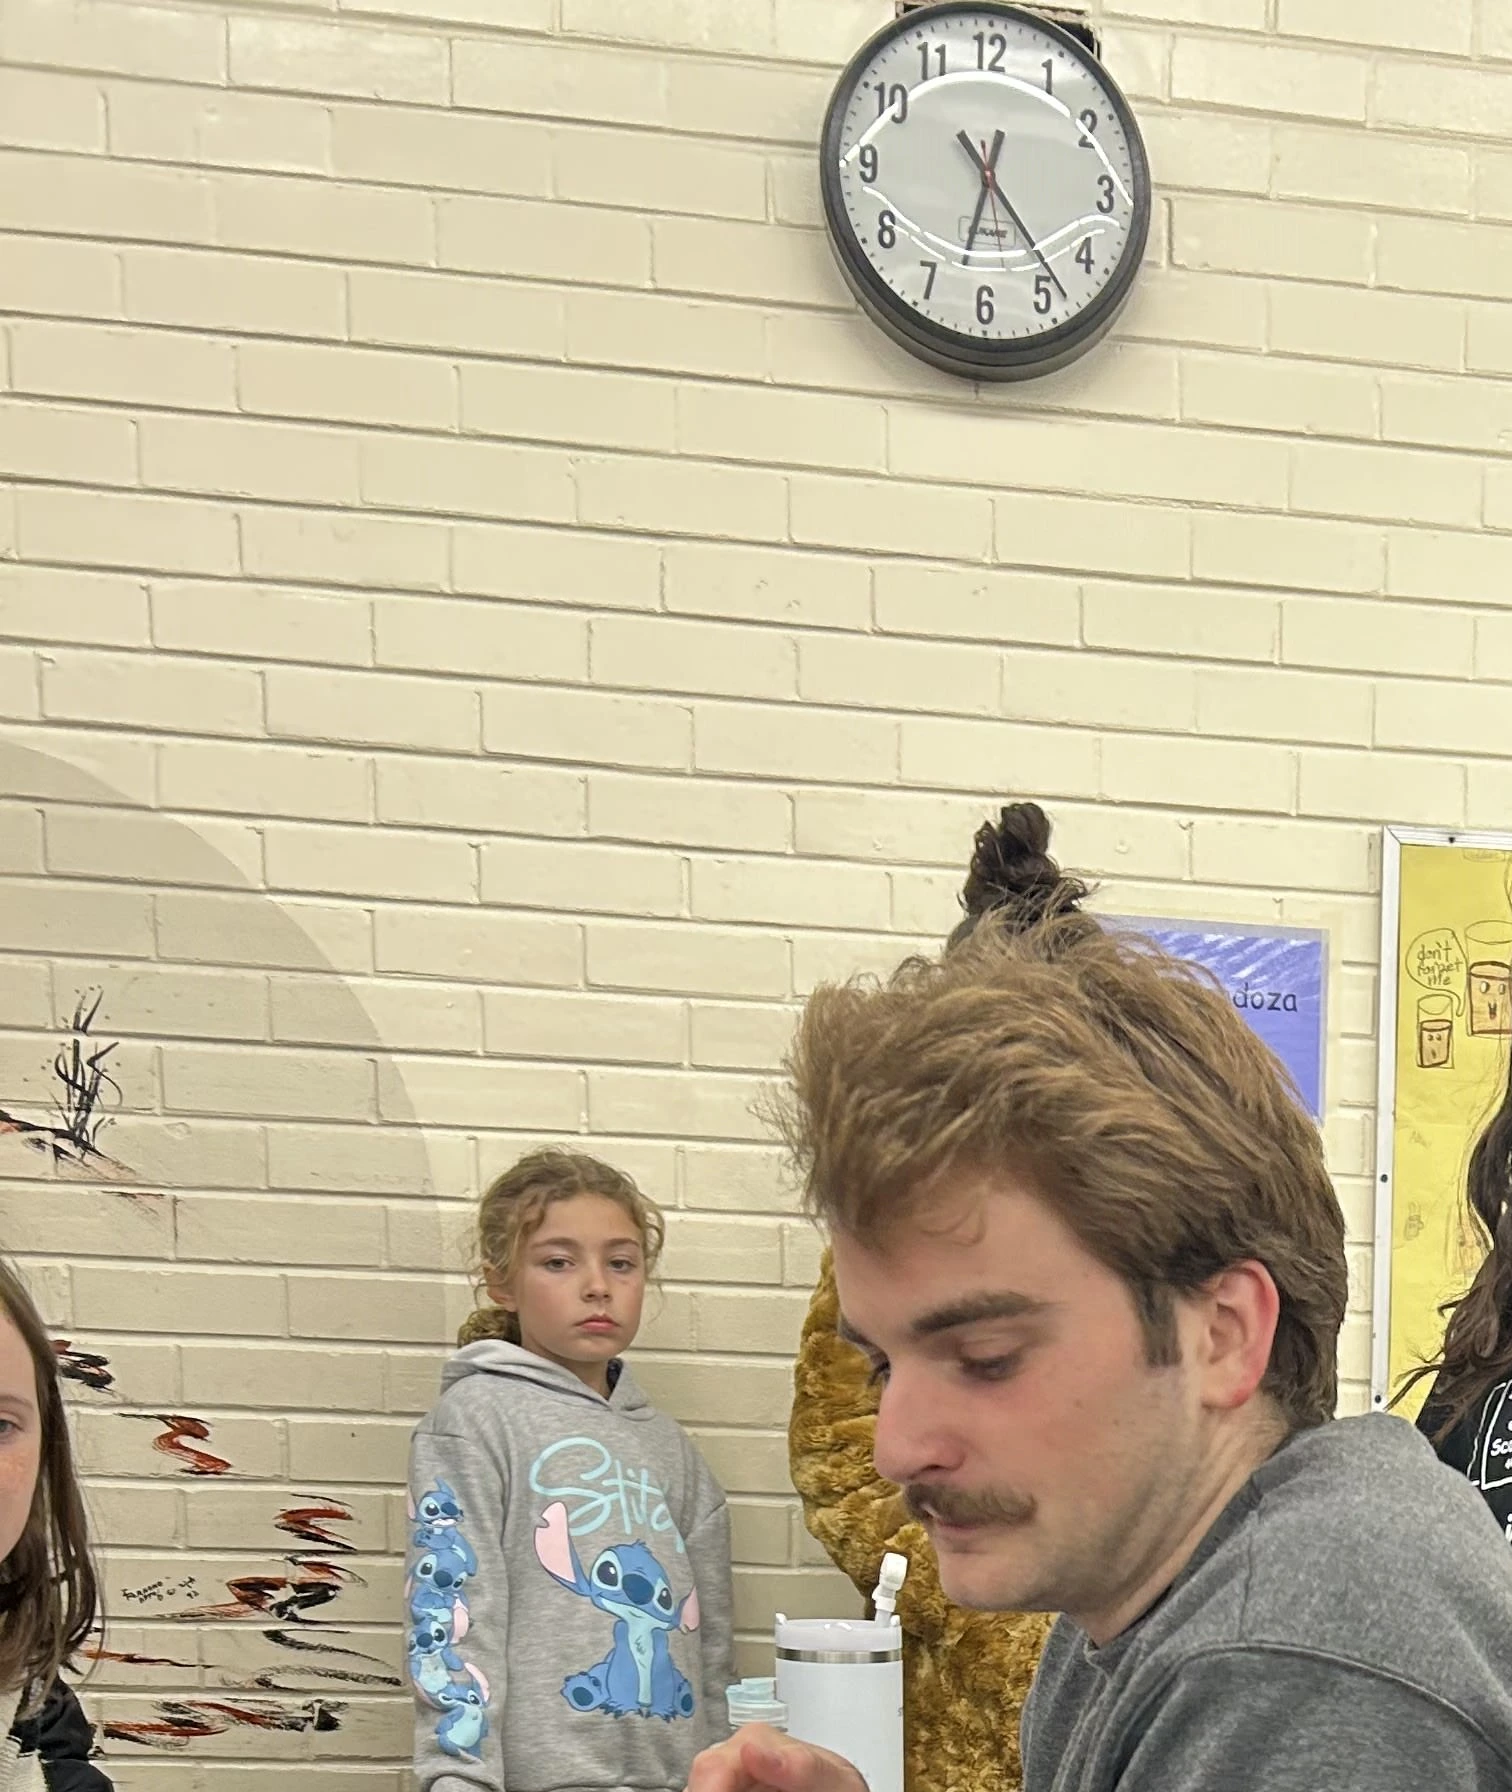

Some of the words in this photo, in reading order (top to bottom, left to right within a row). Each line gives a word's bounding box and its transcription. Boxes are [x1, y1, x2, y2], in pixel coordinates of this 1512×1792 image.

[917, 41, 949, 81] 11
[972, 31, 1008, 73] 12
[1041, 58, 1054, 95] 1
[874, 81, 909, 124] 10
[1077, 109, 1099, 149] 2
[859, 144, 879, 184] 9
[1096, 175, 1115, 214] 3
[877, 210, 897, 249] 8
[1075, 236, 1095, 274] 4
[919, 260, 938, 300] 7
[1033, 275, 1053, 314] 5
[976, 284, 995, 325] 6
[1232, 981, 1298, 1013] doza
